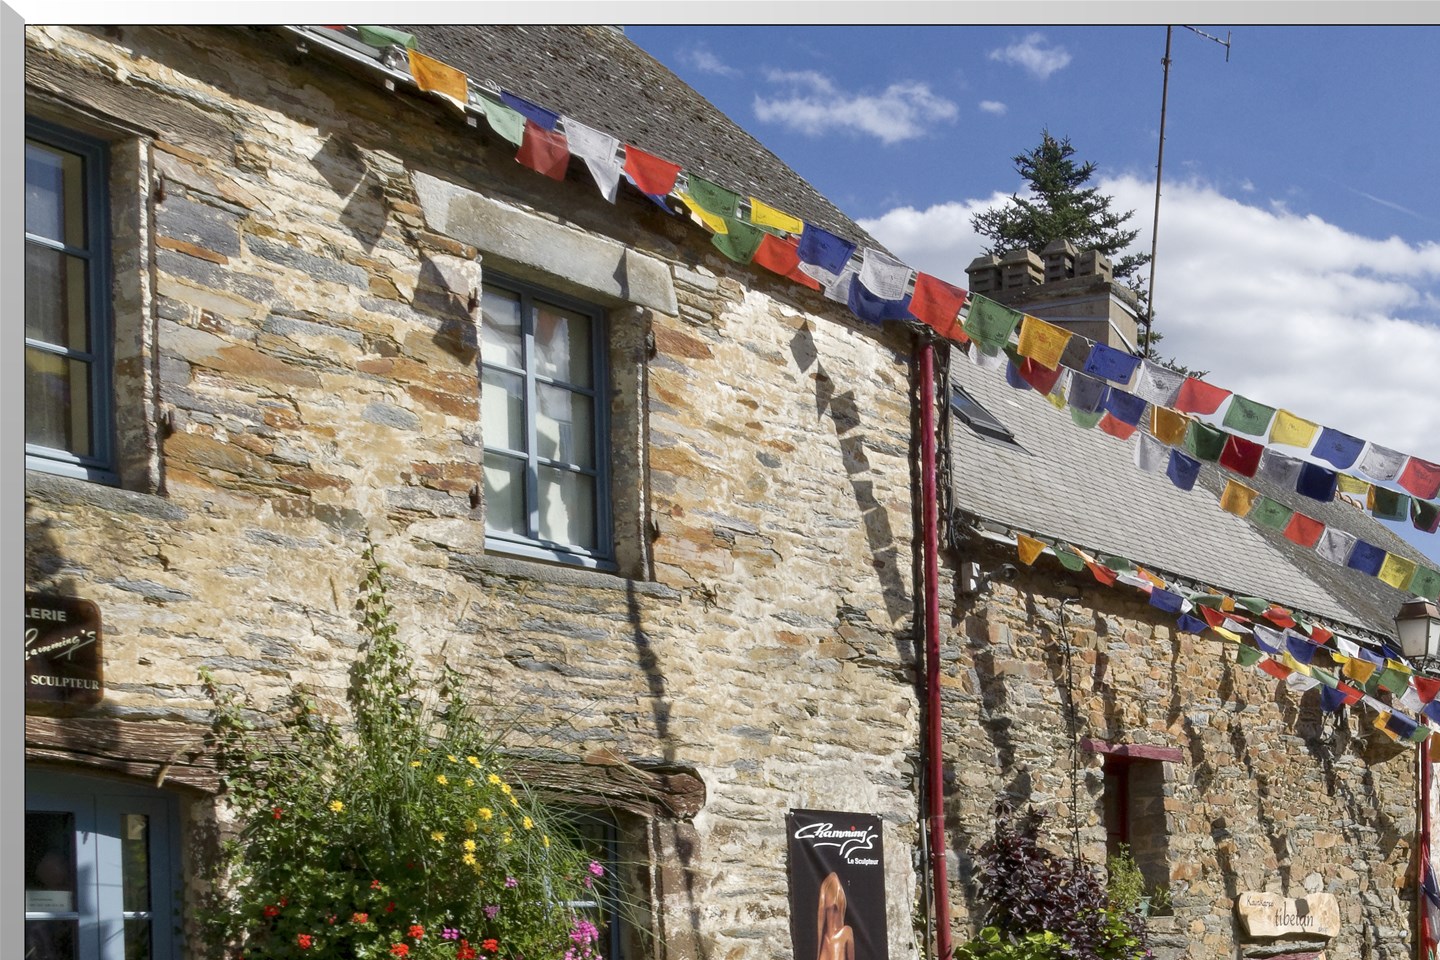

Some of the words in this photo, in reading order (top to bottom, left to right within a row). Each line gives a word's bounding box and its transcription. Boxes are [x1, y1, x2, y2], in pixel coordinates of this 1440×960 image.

[30, 674, 100, 690] SCULPTEUR
[847, 857, 855, 865] Le
[855, 857, 879, 866] Sculpteur
[1274, 901, 1314, 927] tibetan
